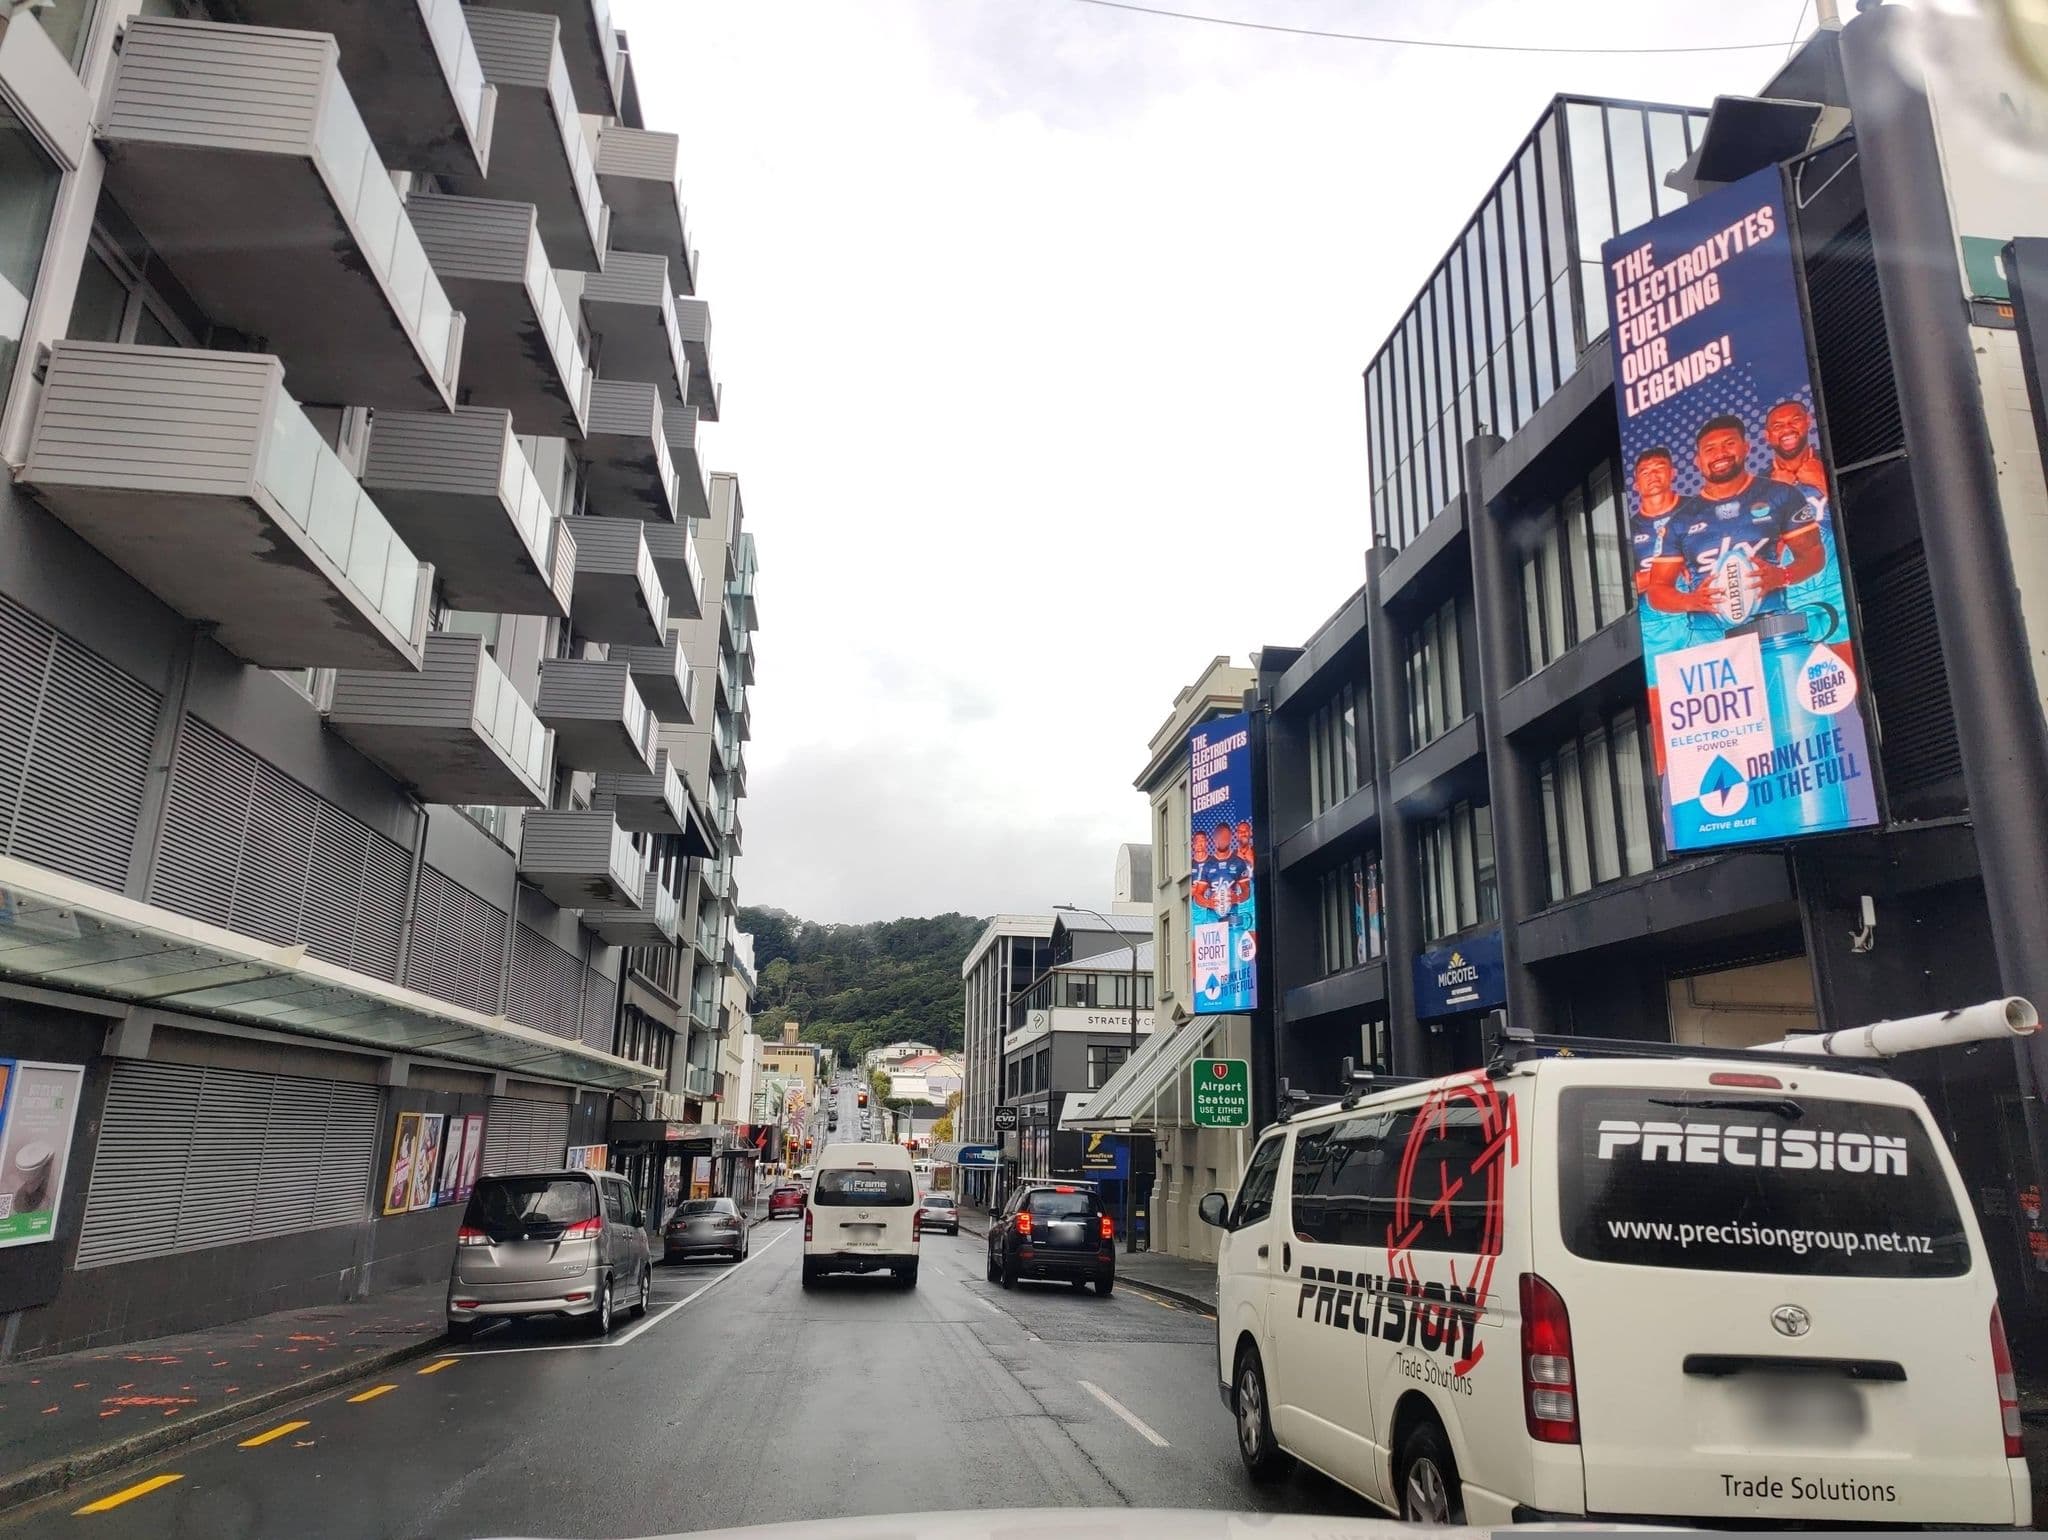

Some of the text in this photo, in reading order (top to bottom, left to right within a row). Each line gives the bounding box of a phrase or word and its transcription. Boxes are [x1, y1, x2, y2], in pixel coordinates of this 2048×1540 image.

[1612, 243, 1654, 289] THE
[1615, 205, 1776, 322] ELECTROLYTES
[1618, 272, 1721, 353] FUELLING
[1622, 336, 1669, 385] OUR
[1625, 335, 1733, 417] LEGENDS!
[1726, 562, 1744, 620] GILBERT
[1680, 657, 1738, 695] VITA
[1809, 670, 1846, 695] SUGAR
[1670, 686, 1755, 730] SPORT
[1811, 689, 1838, 710] FREE
[1192, 733, 1208, 752] THE
[1192, 730, 1247, 768] ELECTROLYTES
[1671, 722, 1764, 748] ELECTRO-LITE
[1696, 739, 1739, 752] POWDER
[1747, 727, 1844, 781] DRINK LIFE
[1192, 755, 1228, 783] FUELLING
[1750, 752, 1861, 808] TO THE FULL
[1192, 779, 1209, 798] OUR
[1193, 785, 1229, 813] LEGENDS!
[1699, 817, 1757, 833] ACTIVE BLUE
[1203, 931, 1221, 945] VITA
[1198, 945, 1226, 960] SPORT
[1438, 966, 1479, 987] MICROTEL
[1198, 1095, 1245, 1105] Seatoun
[1200, 1081, 1242, 1093] Airport
[1200, 1106, 1243, 1115] USE EITHER
[1212, 1115, 1232, 1123] LANE
[1597, 1120, 1908, 1176] PRECISION
[854, 1180, 887, 1188] Frame
[1608, 1221, 1934, 1256] www.precisiongroup.net.nz
[1297, 1265, 1477, 1361] PRECISION
[1396, 1351, 1473, 1396] Trade Solutions
[1721, 1474, 1896, 1502] Trade Solutions
